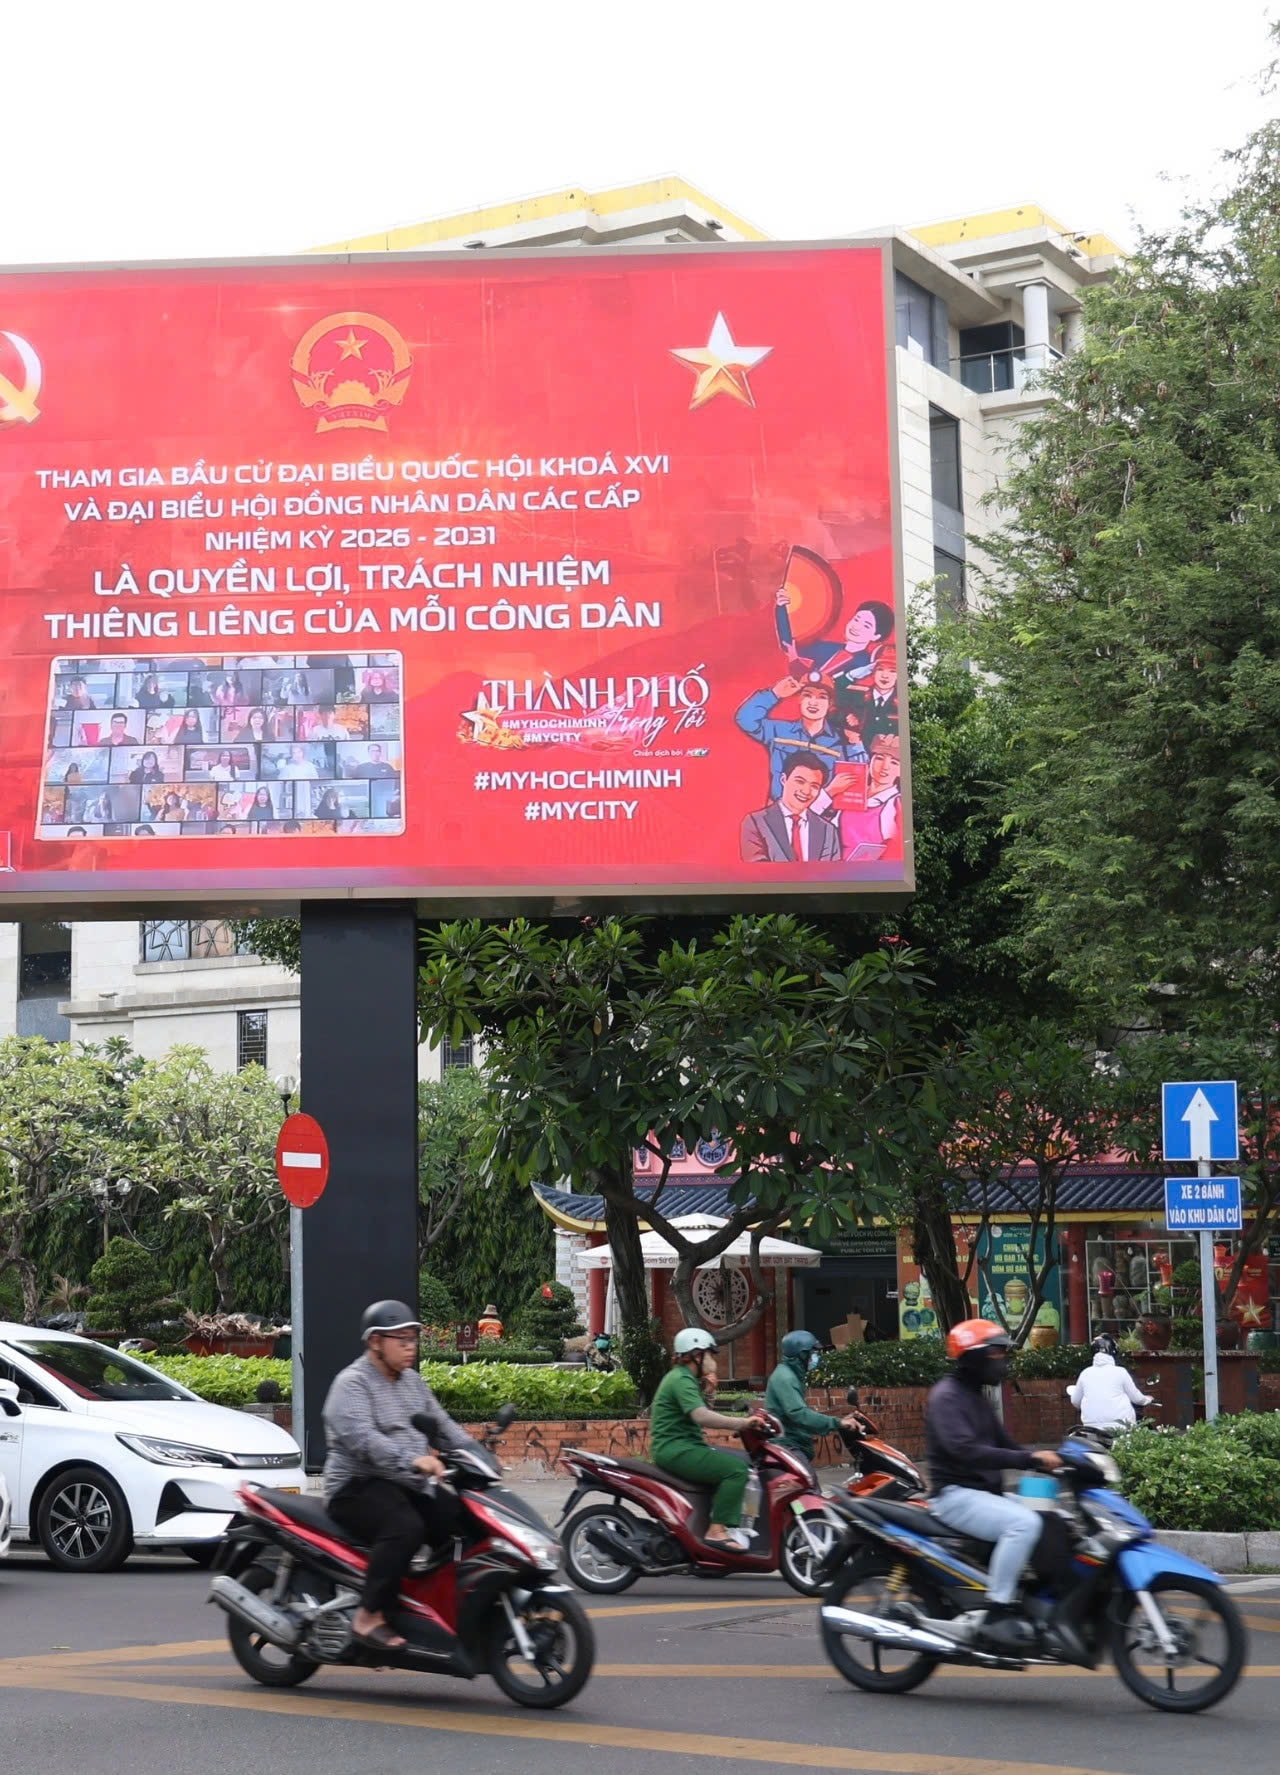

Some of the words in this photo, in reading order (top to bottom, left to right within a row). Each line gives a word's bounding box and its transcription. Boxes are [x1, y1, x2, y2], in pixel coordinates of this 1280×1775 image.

[35, 468, 112, 489] THAM
[119, 466, 165, 488] GIA
[171, 458, 228, 486] BẦU
[234, 459, 273, 484] CỬ
[278, 463, 324, 487] ĐẠI
[331, 454, 394, 483] BIỂU
[400, 453, 480, 483] QUỐC
[486, 454, 532, 482] HỘI
[539, 452, 619, 477] KHOÁ
[624, 454, 670, 475] XVI
[63, 496, 102, 522] VÀ
[108, 500, 154, 524] ĐẠI
[161, 491, 224, 521] BIỂU
[231, 493, 277, 520] HỘI
[284, 489, 363, 516] ĐỒNG
[370, 489, 450, 515] NHÂN
[456, 487, 516, 513] DÂN
[522, 486, 578, 511] CÁC
[584, 481, 642, 510] CẤP
[205, 526, 293, 555] NHIỆM
[299, 524, 335, 550] KỲ
[340, 527, 411, 549] 2026
[433, 525, 497, 547] 2031
[93, 563, 140, 596] LÀ
[147, 557, 276, 598] QUYỀN
[285, 562, 351, 598] LỢI,
[358, 557, 483, 590] TRÁCH
[491, 553, 611, 592] NHIỆM
[43, 606, 180, 639] THIÊNG
[187, 603, 295, 637] LIÊNG
[302, 600, 382, 634] CỦA
[389, 593, 457, 632] MỖI
[464, 598, 571, 632] CÔNG
[579, 595, 663, 629] DÂN
[482, 671, 618, 711] THÀNH
[625, 663, 711, 708] PHỐ
[501, 717, 608, 730] #MYHOCHIMINH
[523, 731, 583, 743] #MYCITY
[474, 768, 681, 790] #MYHOCHIMINH
[524, 800, 638, 821] #MYCITY
[1181, 1185, 1193, 1200] XE
[1195, 1186, 1200, 1199] 2
[1202, 1181, 1225, 1199] BÁNH
[1169, 1206, 1187, 1224] VÀO
[1188, 1209, 1205, 1223] KHU
[1208, 1206, 1224, 1223] DÂN
[1226, 1206, 1239, 1223] CƯ
